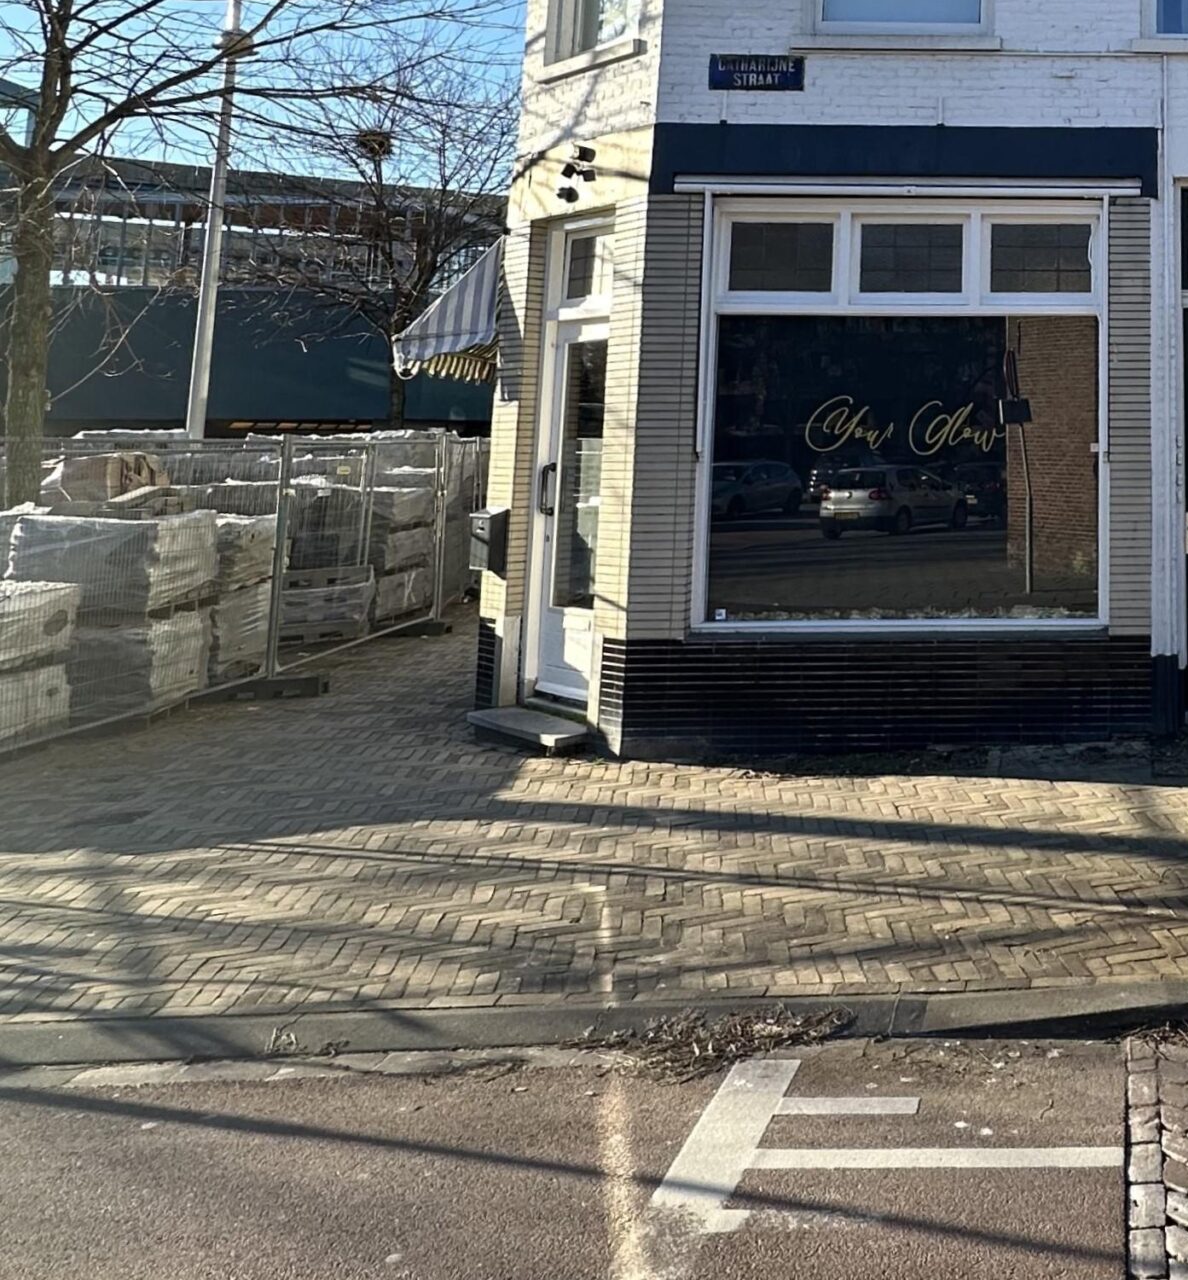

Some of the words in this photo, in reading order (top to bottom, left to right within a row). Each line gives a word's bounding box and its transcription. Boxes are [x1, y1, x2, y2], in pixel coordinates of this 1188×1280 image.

[733, 73, 781, 87] STRAAT
[804, 395, 895, 452] Your
[908, 400, 1006, 456] Glow
